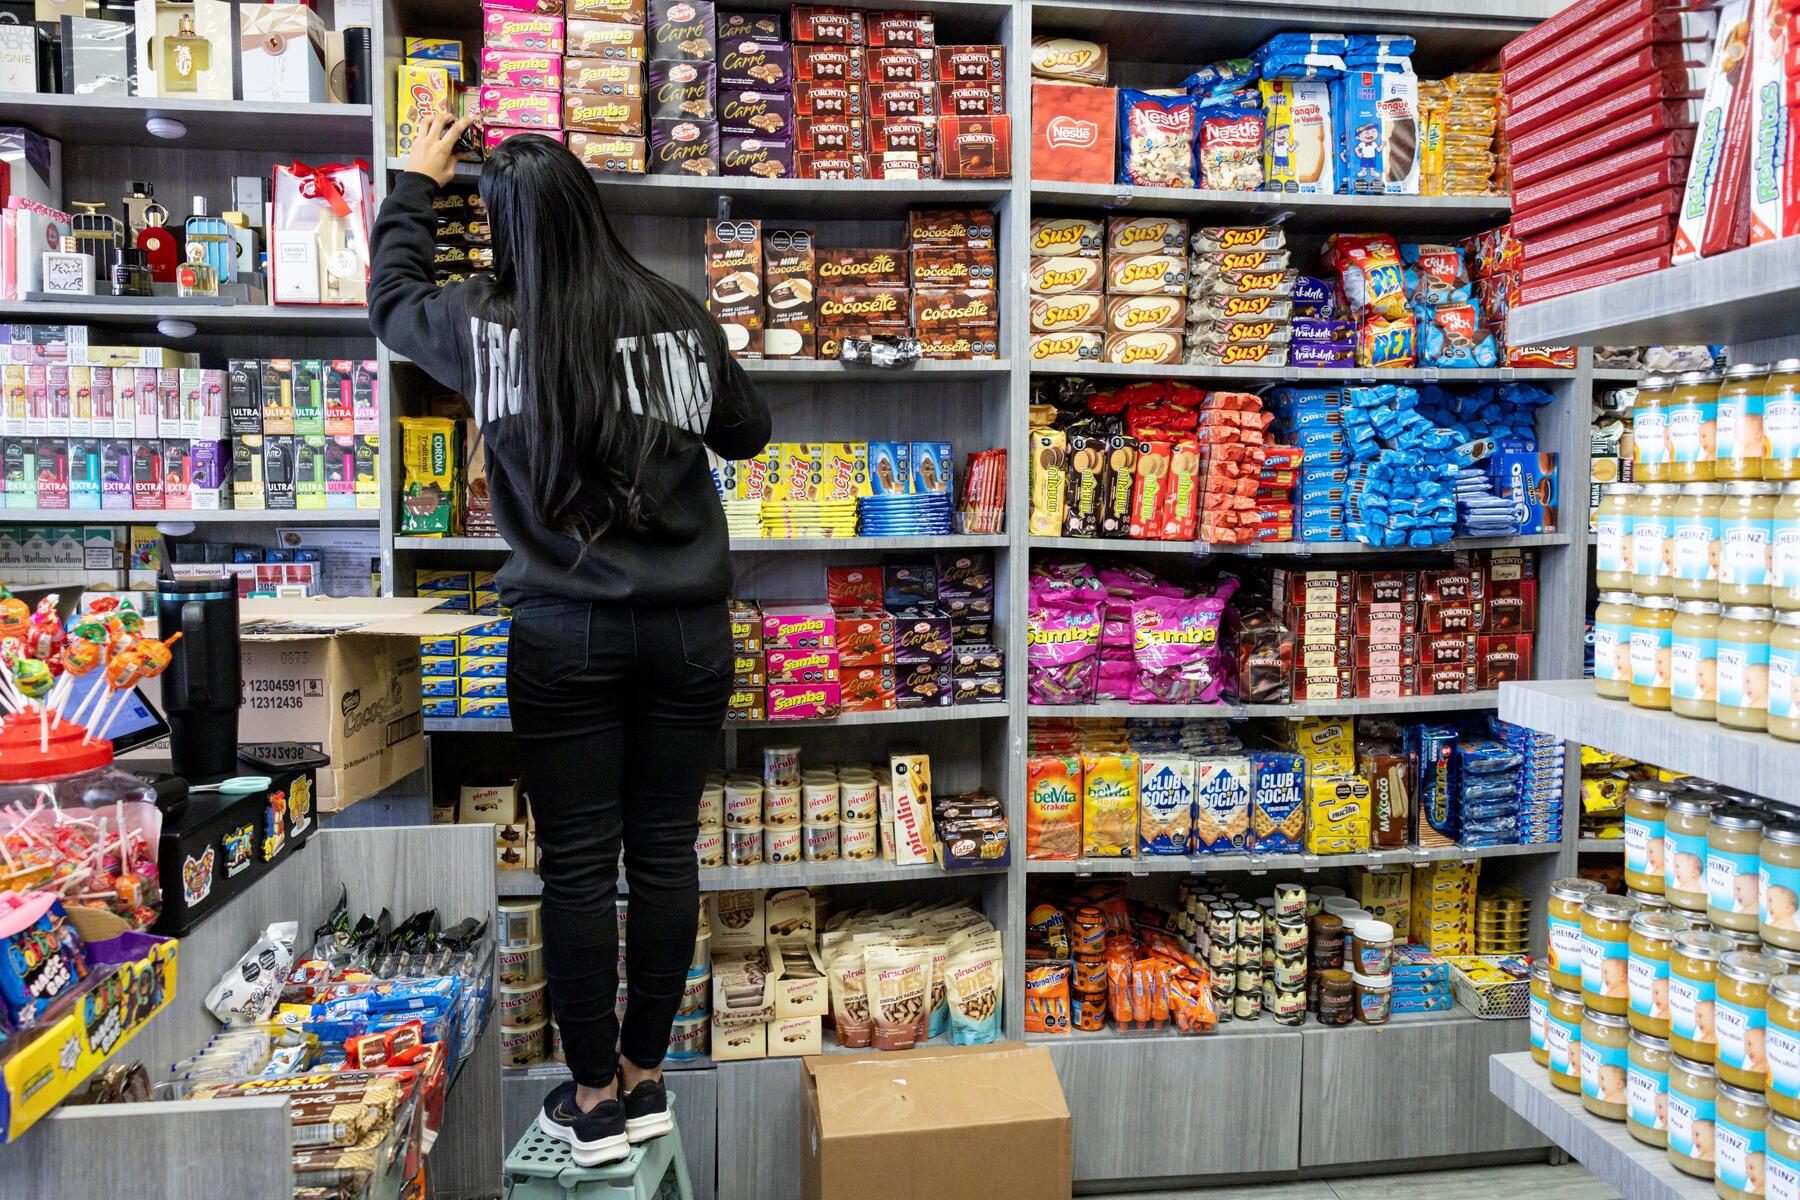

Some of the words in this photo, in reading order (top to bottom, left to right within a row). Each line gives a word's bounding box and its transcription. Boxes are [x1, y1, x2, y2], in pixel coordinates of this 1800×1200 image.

[810, 16, 849, 25] TORONTO
[881, 20, 919, 29] TORONTO
[656, 21, 704, 43] Carré
[723, 51, 766, 71] Carré
[809, 54, 848, 63] TORONTO
[880, 56, 918, 65] TORONTO
[951, 54, 989, 63] TORONTO
[658, 81, 705, 103] Carré
[809, 89, 847, 98] TORONTO
[882, 91, 920, 100] TORONTO
[952, 89, 990, 98] TORONTO
[724, 101, 767, 120] Carré
[810, 125, 849, 134] TORONTO
[883, 126, 921, 134] TORONTO
[1053, 126, 1090, 140] Nestlé
[957, 134, 995, 144] TORONTO
[660, 140, 708, 161] Carré
[725, 150, 768, 168] Carré
[812, 160, 850, 169] TORONTO
[882, 161, 919, 170] TORONTO
[913, 224, 967, 239] Cocosette
[1035, 224, 1086, 248] Susy
[1120, 223, 1167, 246] Susy
[1220, 227, 1268, 249] Susy
[819, 255, 895, 277] Cocosette
[915, 263, 968, 278] Cocosette
[1121, 261, 1169, 284] Susy
[1041, 268, 1087, 289] Susy
[1238, 270, 1284, 292] Susy
[821, 293, 897, 315] Cocosette
[921, 300, 988, 321] Cocosette
[1224, 296, 1271, 316] Susy
[1043, 304, 1090, 326] Susy
[1124, 306, 1171, 326] Susy
[1229, 321, 1275, 342] Susy
[1034, 336, 1084, 359] Susy
[1121, 343, 1167, 363] Susy
[1222, 345, 1269, 364] Susy
[232, 408, 259, 416] ULTRA
[265, 408, 291, 417] ULTRA
[295, 408, 321, 416] ULTRA
[326, 408, 352, 417] ULTRA
[7, 482, 34, 490] EXTRA
[40, 482, 67, 491] EXTRA
[71, 482, 98, 490] EXTRA
[104, 482, 131, 490] EXTRA
[136, 482, 163, 491] EXTRA
[237, 482, 263, 491] ULTRA
[268, 482, 294, 491] ULTRA
[299, 482, 324, 491] ULTRA
[328, 482, 354, 491] ULTRA
[195, 568, 221, 576] Newport
[258, 583, 275, 591] 305
[777, 620, 825, 636] Samba
[1135, 627, 1216, 650] Samba
[783, 654, 829, 671] Samba
[250, 680, 301, 692] 12304591
[250, 697, 303, 708] 12312436
[774, 690, 825, 712] Samba
[1148, 775, 1183, 790] CLUB
[1206, 777, 1240, 793] CLUB
[1261, 772, 1295, 788] CLUB
[1033, 785, 1077, 803] belVita
[897, 795, 927, 857] pirulin
